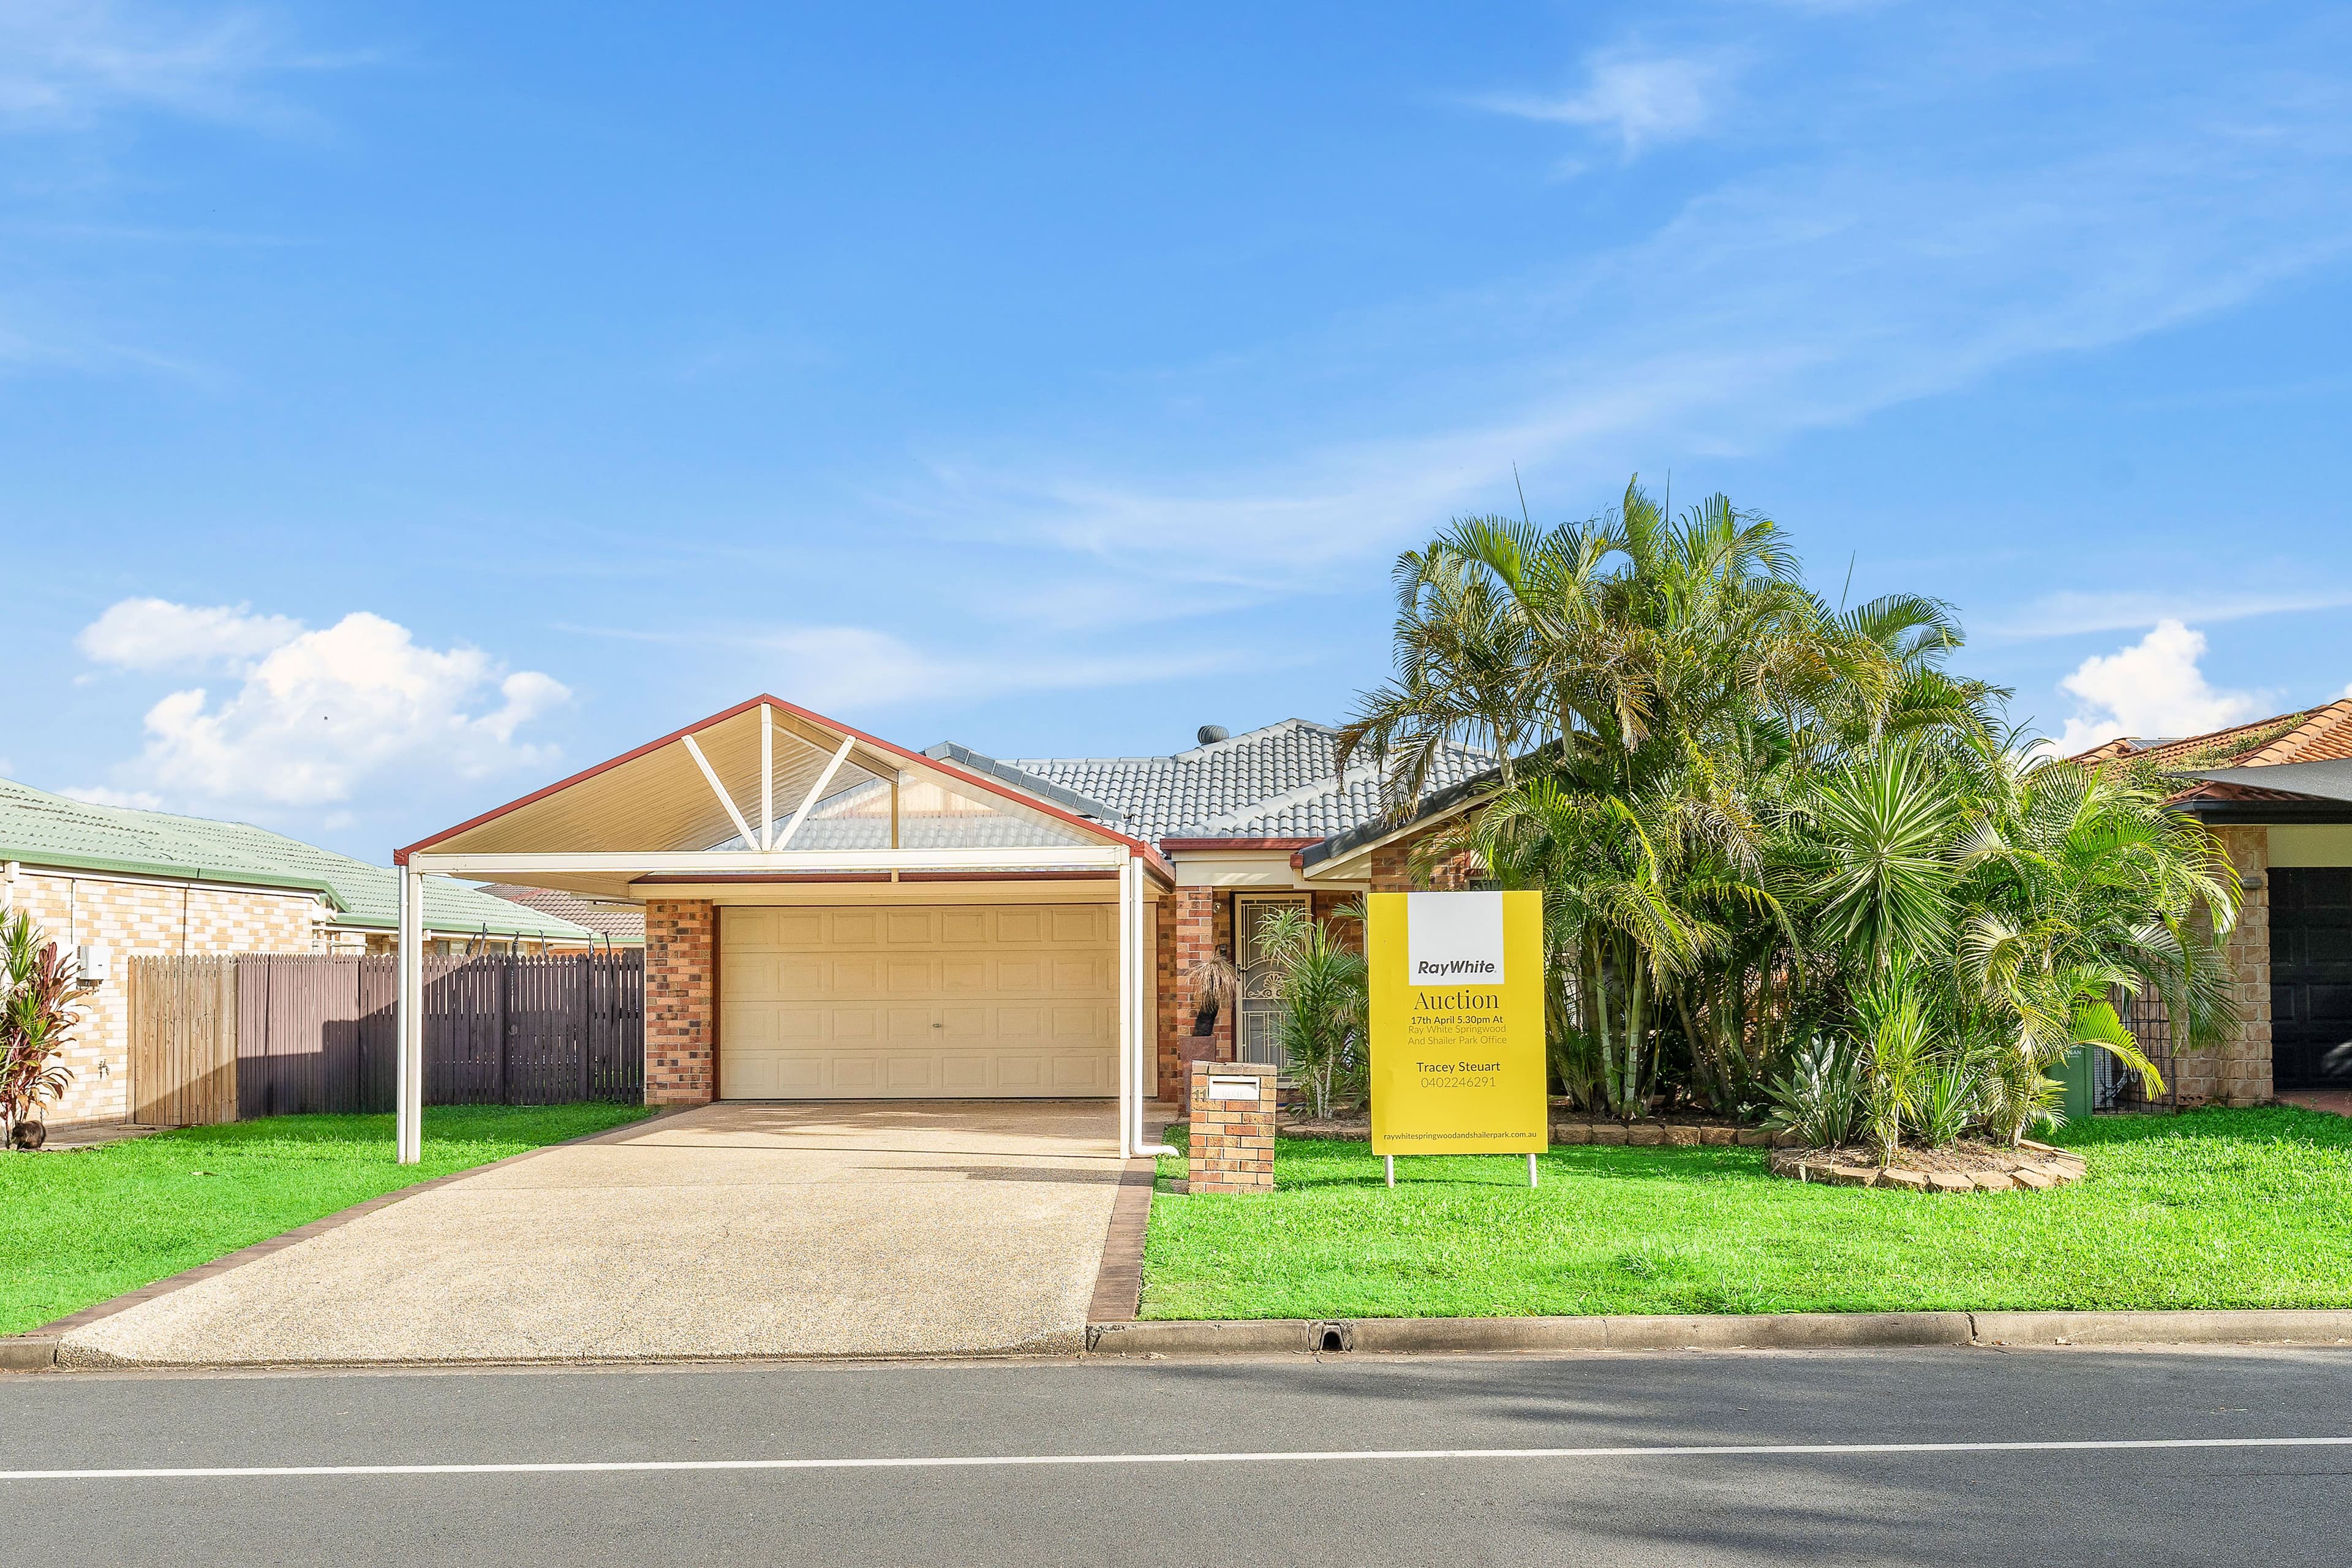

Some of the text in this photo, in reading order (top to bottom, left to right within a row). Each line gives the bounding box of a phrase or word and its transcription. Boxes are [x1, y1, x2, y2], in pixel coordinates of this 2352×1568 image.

[1414, 990, 1499, 1009] Auction
[1411, 1015, 1504, 1025] 17th April 5.30pm At
[1408, 1024, 1506, 1035] Ray White Springwood
[1408, 1035, 1507, 1045] And Shailer Park Office
[1416, 1061, 1501, 1074] Tracey Steuart
[1421, 1076, 1496, 1088] 0402246291
[1192, 1090, 1207, 1102] 11
[1384, 1131, 1537, 1140] raywhitespringwoodandshailerpark.com.au
